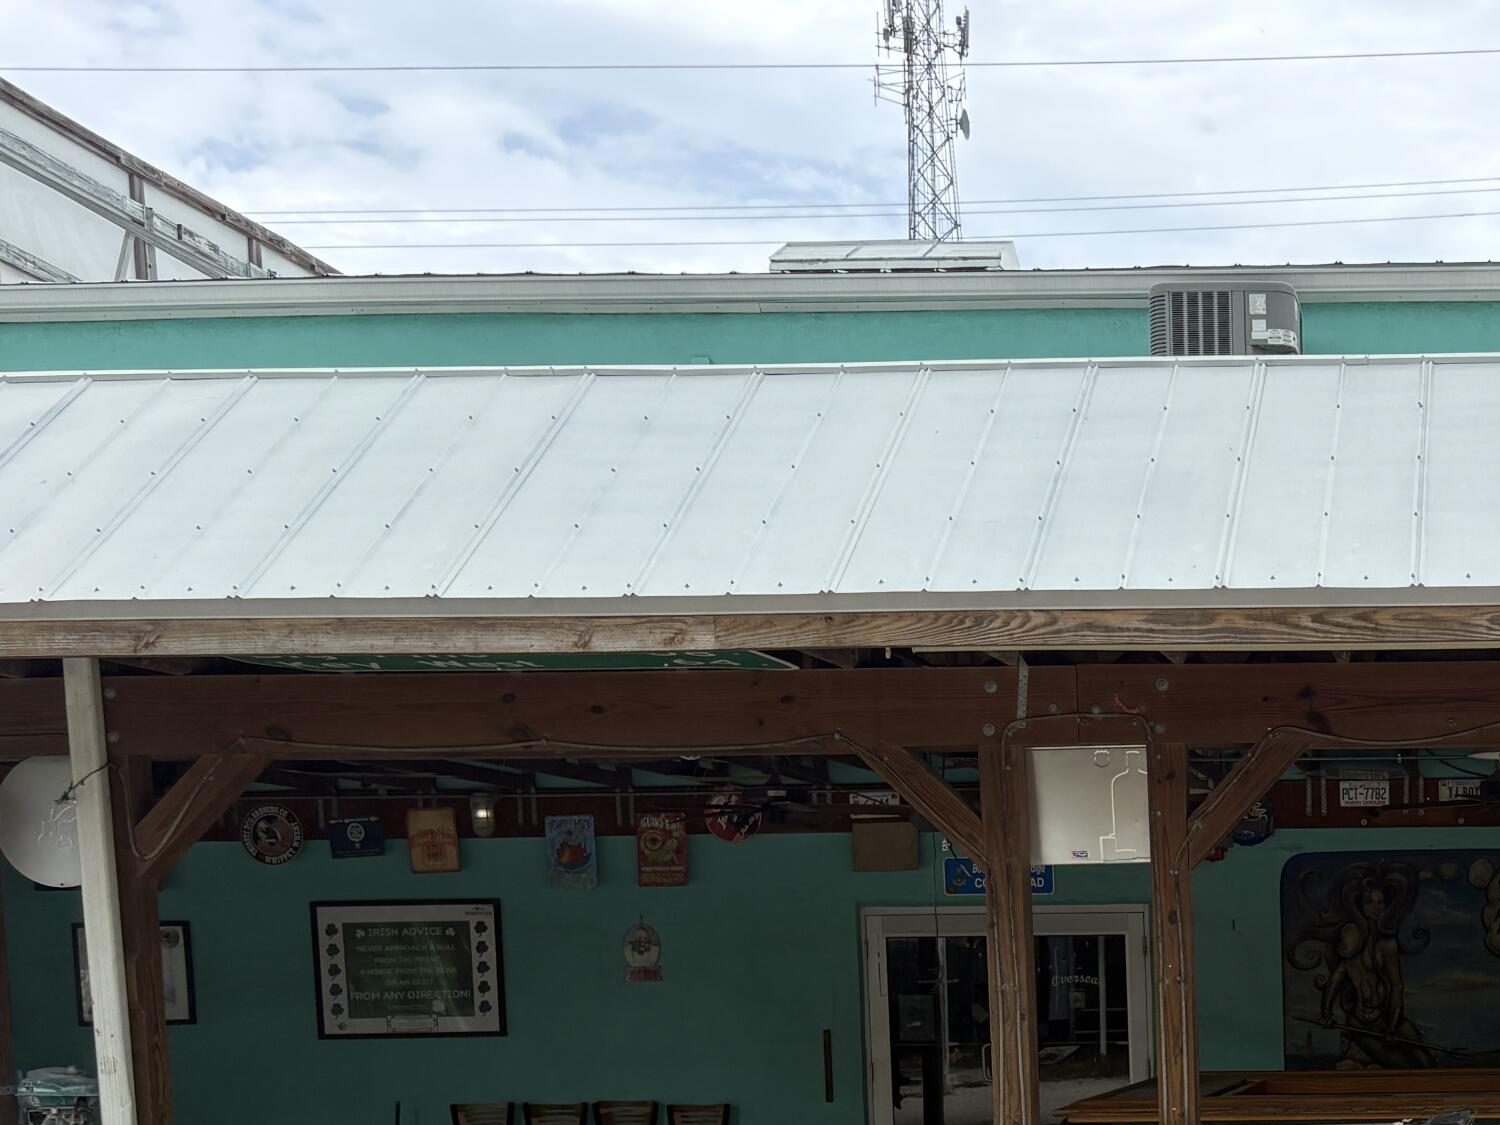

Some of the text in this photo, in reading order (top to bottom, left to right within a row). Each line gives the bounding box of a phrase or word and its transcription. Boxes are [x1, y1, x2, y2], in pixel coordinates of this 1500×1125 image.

[1342, 787, 1387, 800] PCT-7782
[367, 926, 443, 937] IRISH ADVICE
[383, 990, 405, 1001] ANY
